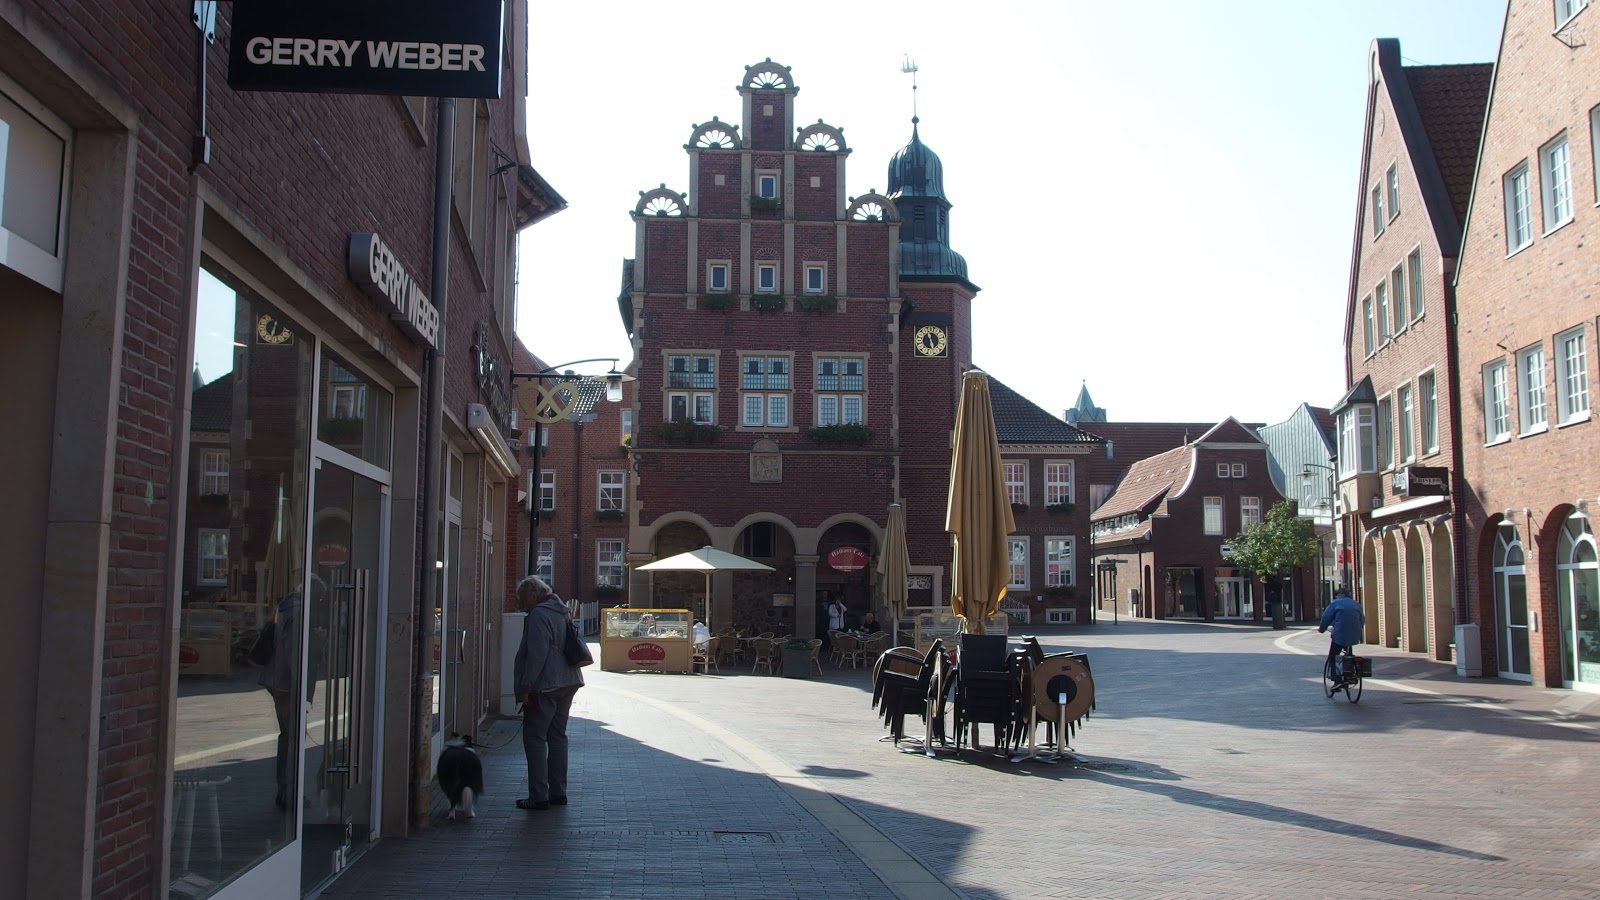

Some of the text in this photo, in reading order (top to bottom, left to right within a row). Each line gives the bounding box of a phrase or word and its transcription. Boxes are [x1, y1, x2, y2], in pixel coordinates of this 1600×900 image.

[246, 37, 486, 72] GERRY WEBER
[369, 232, 439, 351] GERRY WEBER
